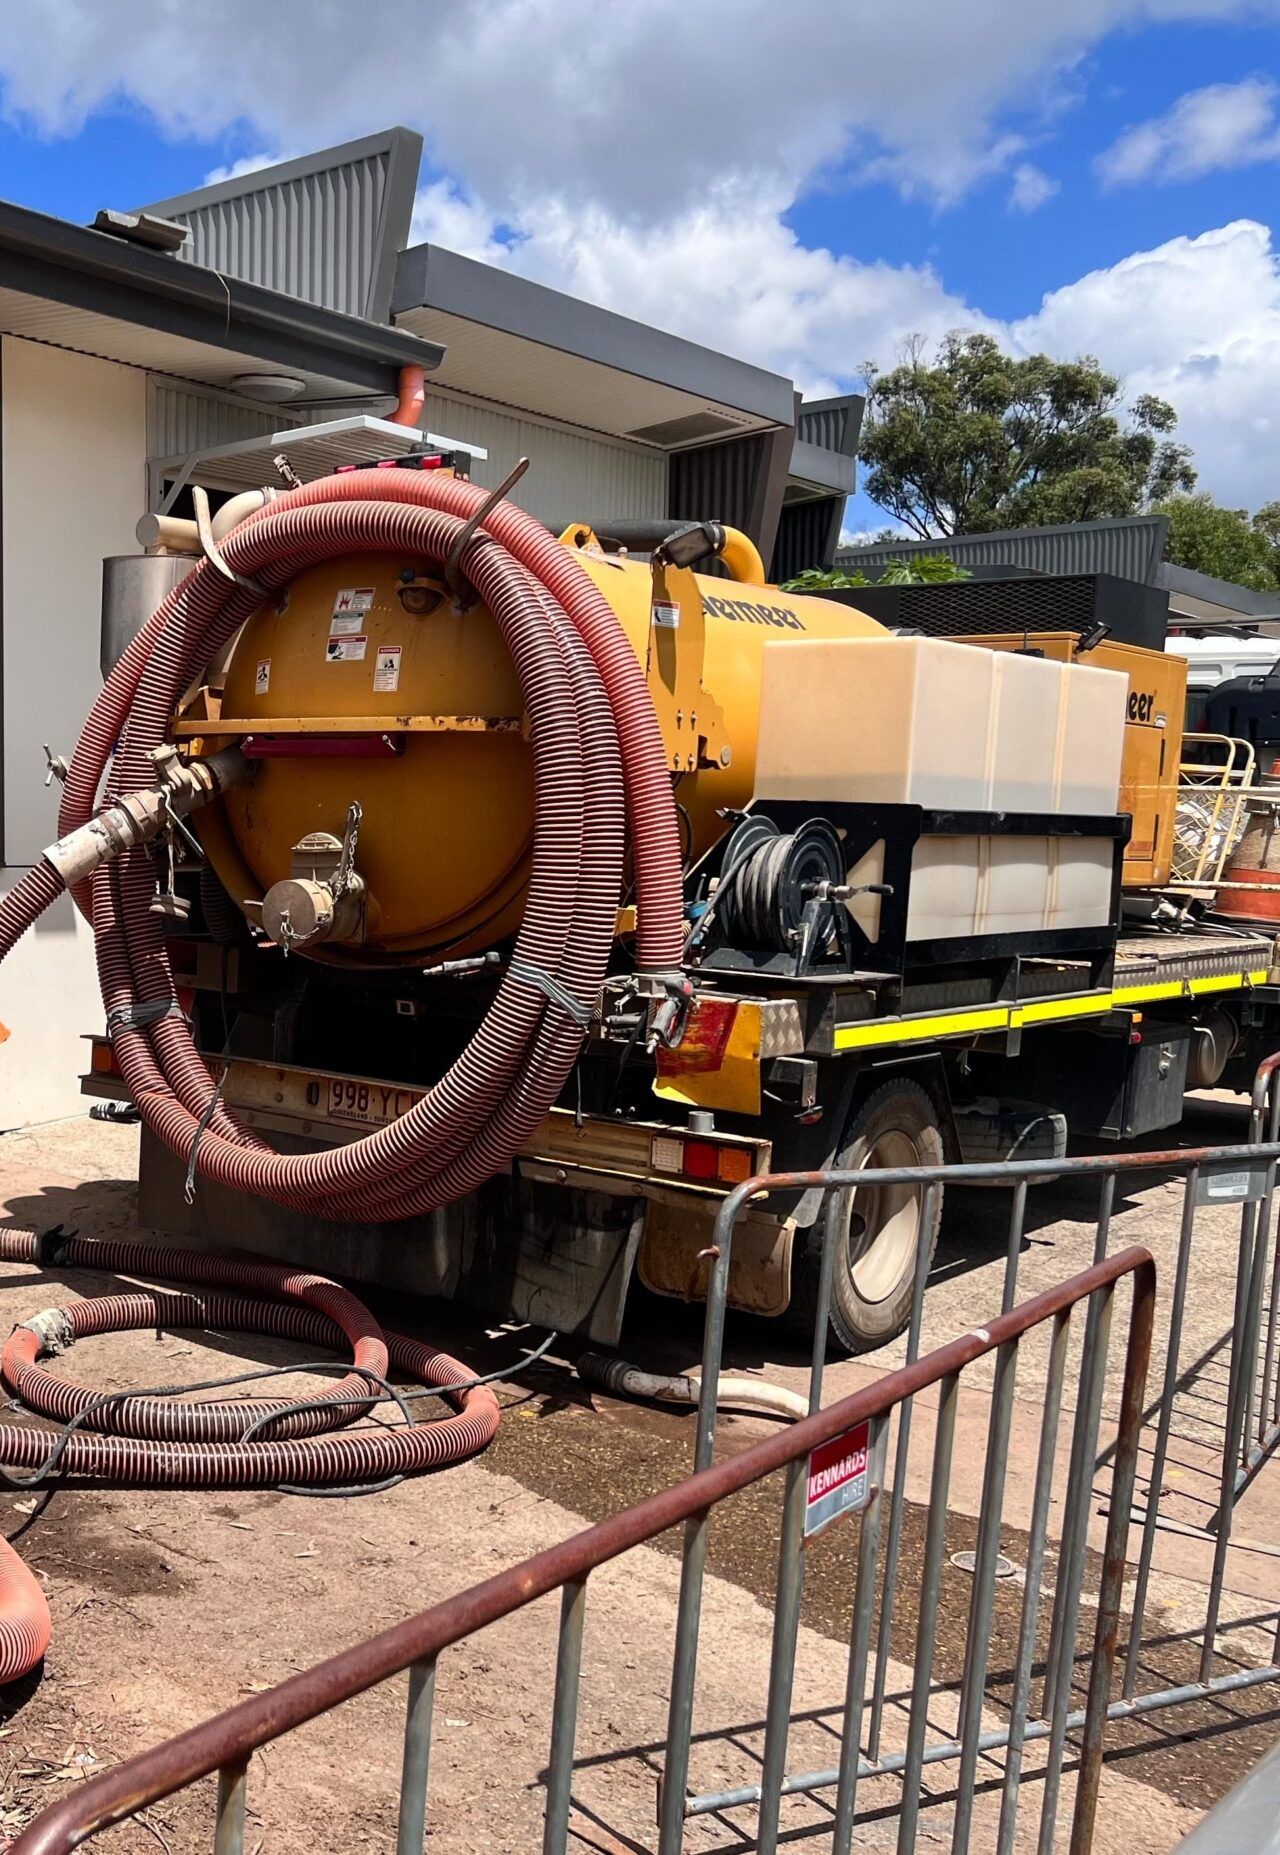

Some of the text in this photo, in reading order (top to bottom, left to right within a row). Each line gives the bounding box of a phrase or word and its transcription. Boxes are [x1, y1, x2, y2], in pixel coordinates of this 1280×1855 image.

[1125, 691, 1154, 722] eer
[809, 1446, 867, 1498] KENNARDS
[842, 1478, 863, 1505] HIRE
